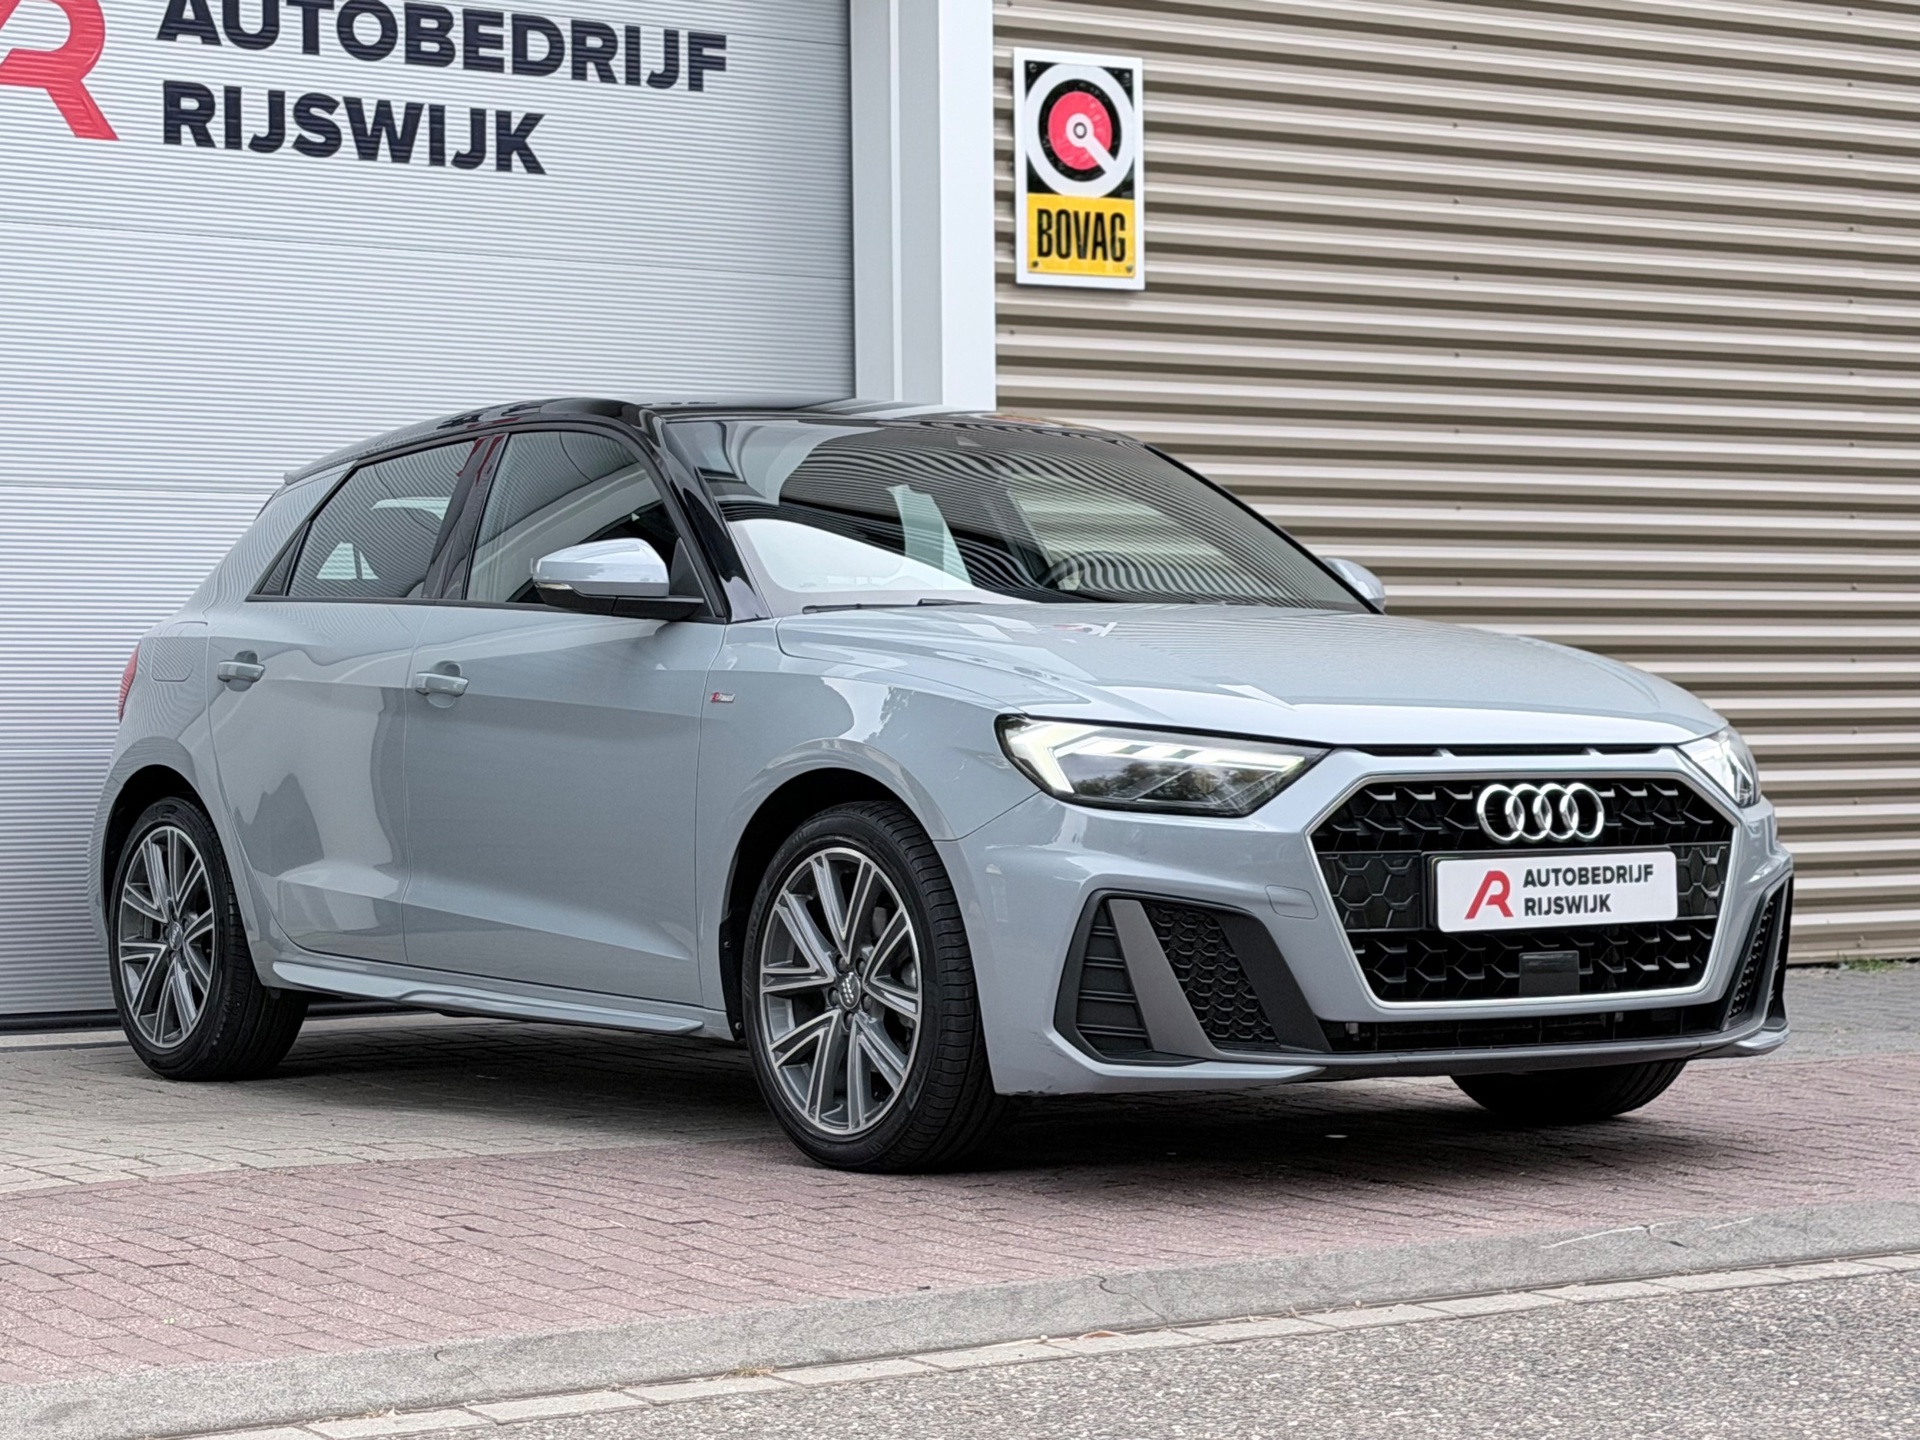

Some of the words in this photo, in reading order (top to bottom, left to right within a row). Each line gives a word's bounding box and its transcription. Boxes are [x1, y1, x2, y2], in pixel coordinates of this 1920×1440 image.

[156, 0, 727, 92] AUTOBEDRIJF
[163, 80, 546, 175] RIJSWIJK
[1036, 208, 1127, 263] BOVAG
[1522, 864, 1655, 889] AUTOBEDRIJF
[1523, 893, 1612, 917] RIJSWIJK
